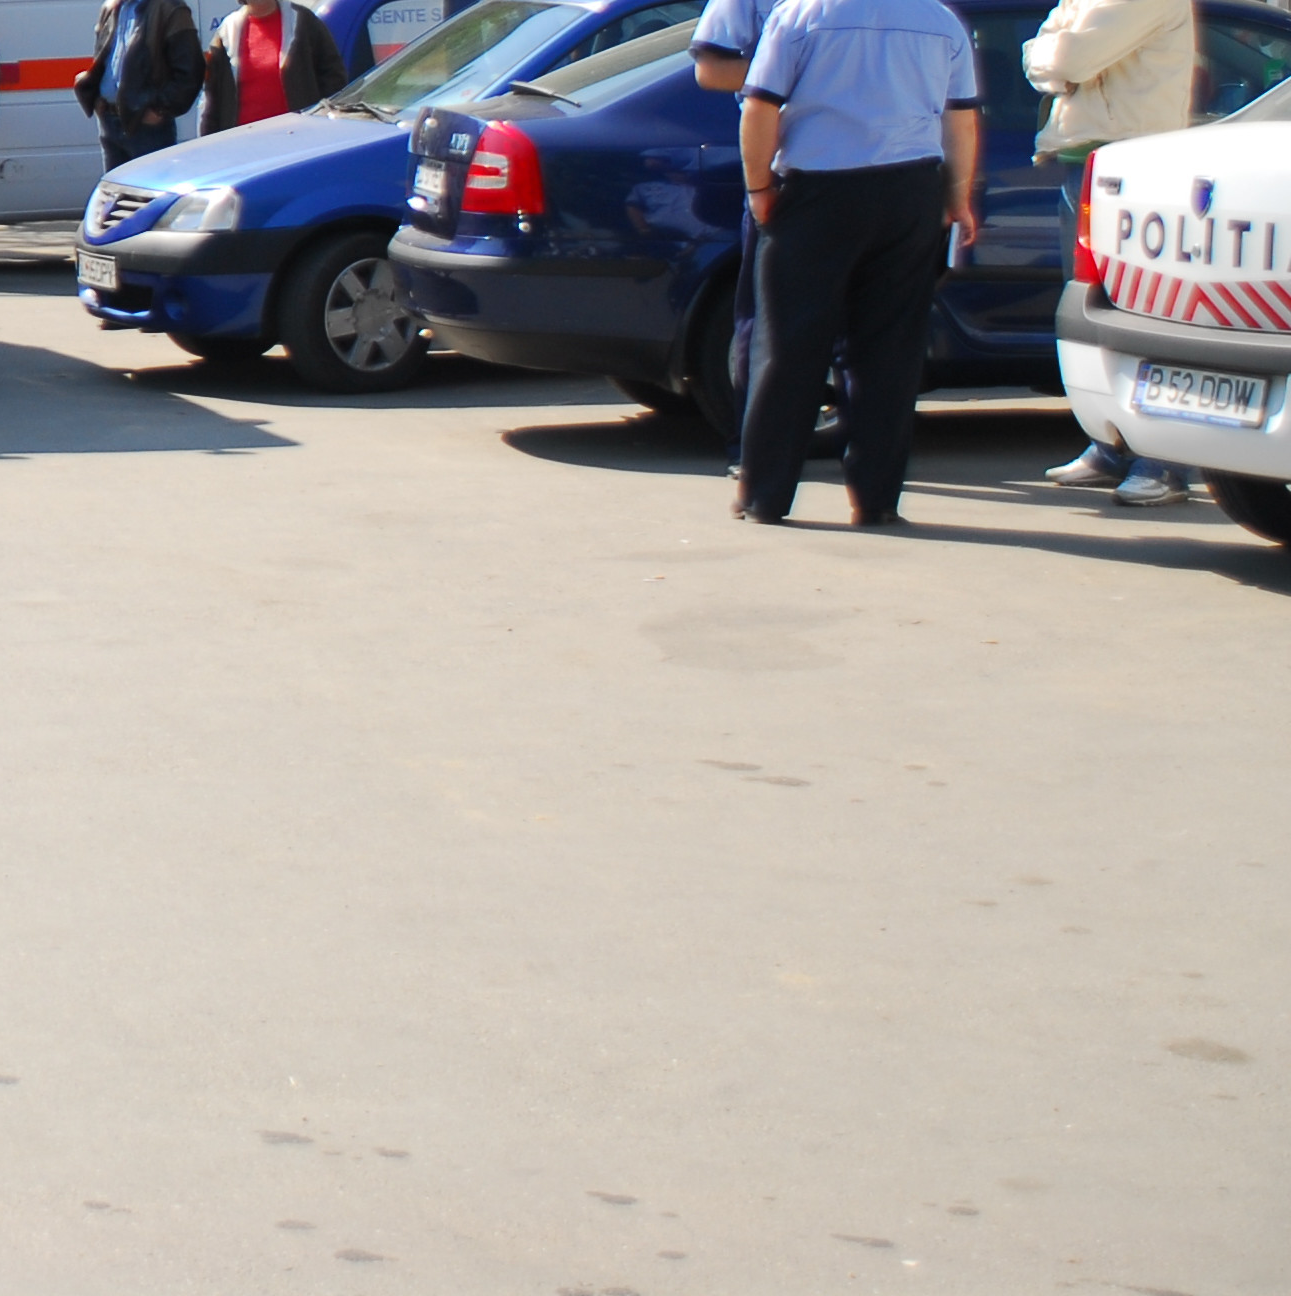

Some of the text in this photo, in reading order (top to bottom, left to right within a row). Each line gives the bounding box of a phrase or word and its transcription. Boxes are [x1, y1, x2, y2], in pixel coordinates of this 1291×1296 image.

[1115, 209, 1291, 273] POLITI
[1146, 368, 1255, 414] B 52 DDW
